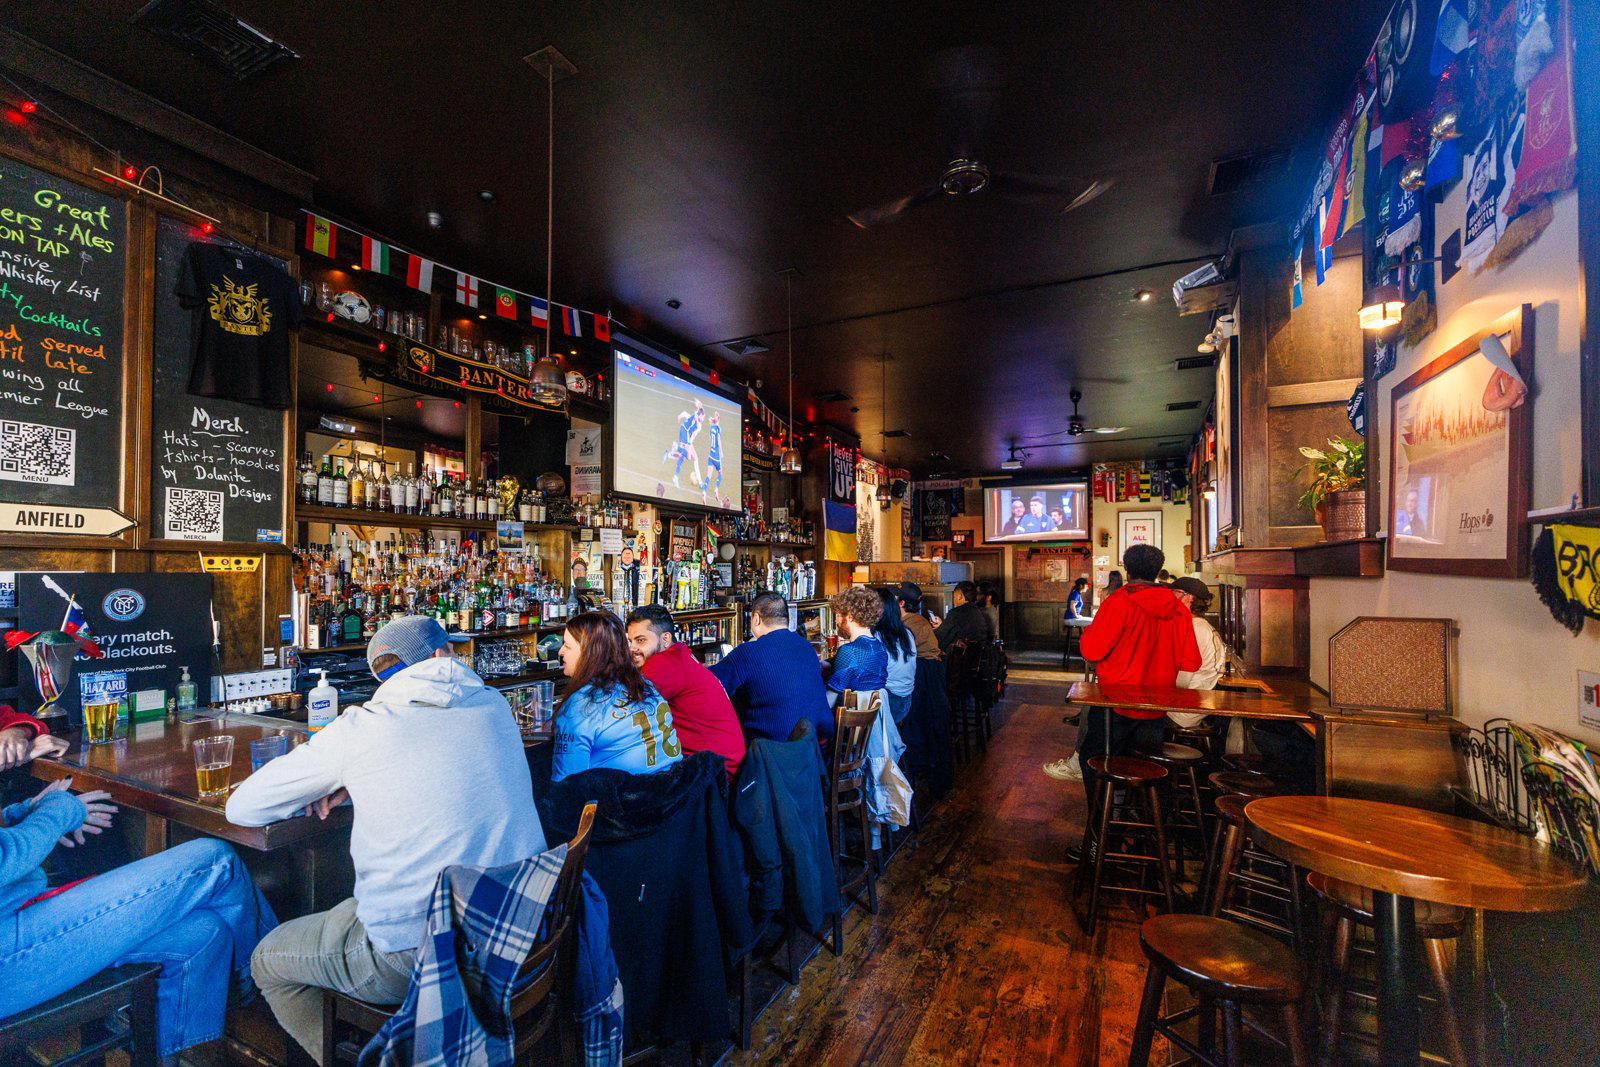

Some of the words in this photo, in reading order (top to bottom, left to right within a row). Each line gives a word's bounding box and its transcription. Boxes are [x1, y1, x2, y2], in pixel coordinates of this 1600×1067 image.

[33, 189, 111, 231] Great
[29, 234, 70, 258] TAP
[69, 223, 115, 253] Ales
[0, 260, 62, 295] Whiskey
[66, 280, 102, 302] List
[19, 305, 102, 337] Cocktails
[58, 378, 85, 394] all
[459, 365, 528, 400] BANTER
[55, 392, 110, 419] League
[191, 406, 250, 434] Merch.
[162, 430, 199, 447] Hats
[229, 453, 281, 472] hoodies
[833, 446, 853, 463] NEVER
[160, 464, 178, 484] by
[833, 457, 854, 477] GIVE
[22, 474, 49, 483] MENU
[834, 472, 854, 499] UP
[228, 483, 272, 503] Designs
[15, 510, 85, 529] ANFIELD
[1459, 512, 1481, 533] Hops
[92, 633, 118, 647] ery
[121, 628, 175, 643] match.
[84, 680, 126, 694] HAZARD
